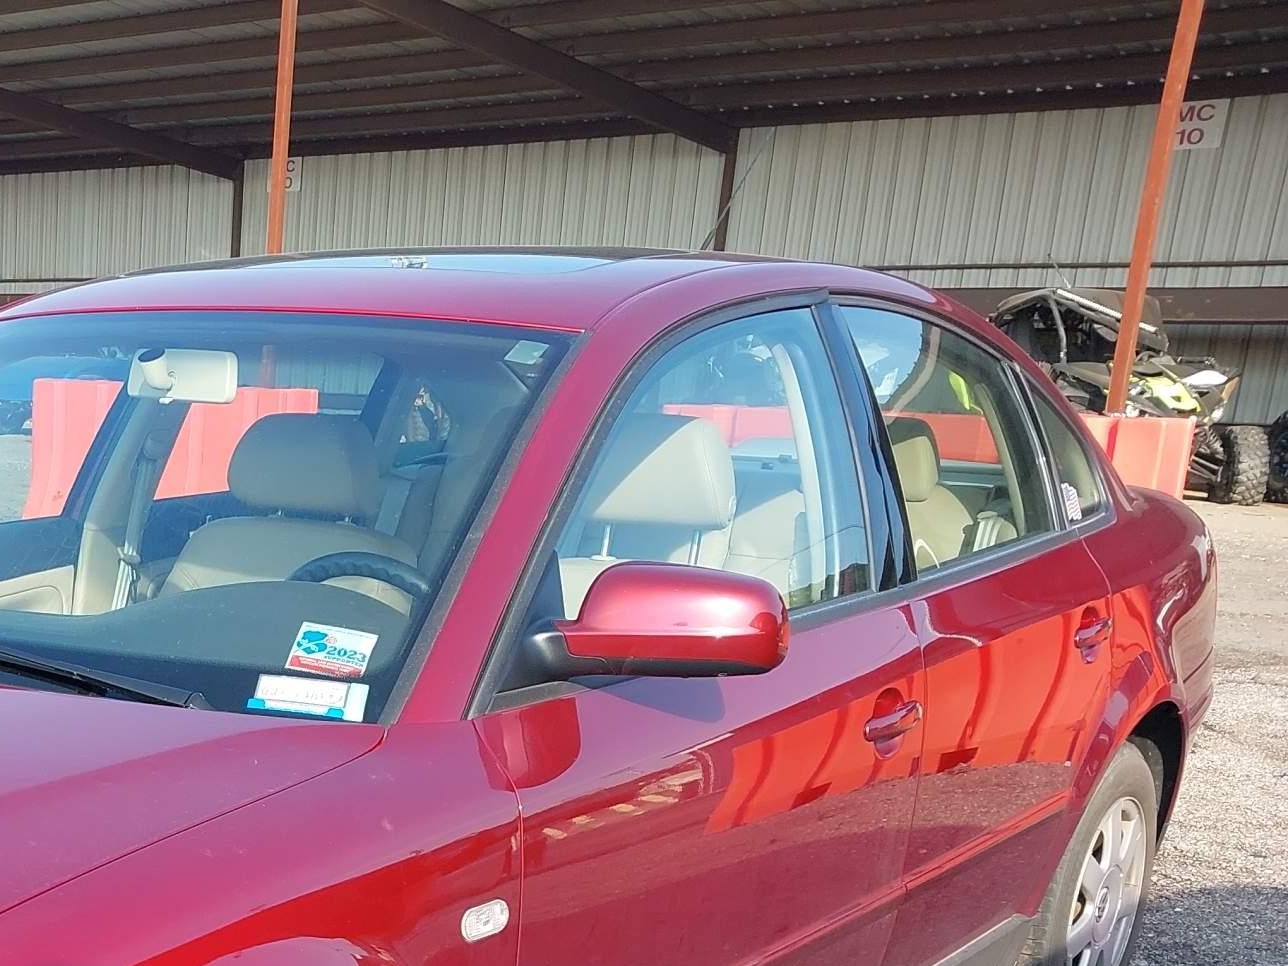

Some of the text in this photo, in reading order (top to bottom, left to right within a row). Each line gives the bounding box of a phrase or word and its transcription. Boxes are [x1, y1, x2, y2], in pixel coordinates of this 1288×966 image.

[1180, 104, 1216, 122] MC
[1176, 128, 1205, 145] 10
[326, 645, 367, 663] 2023
